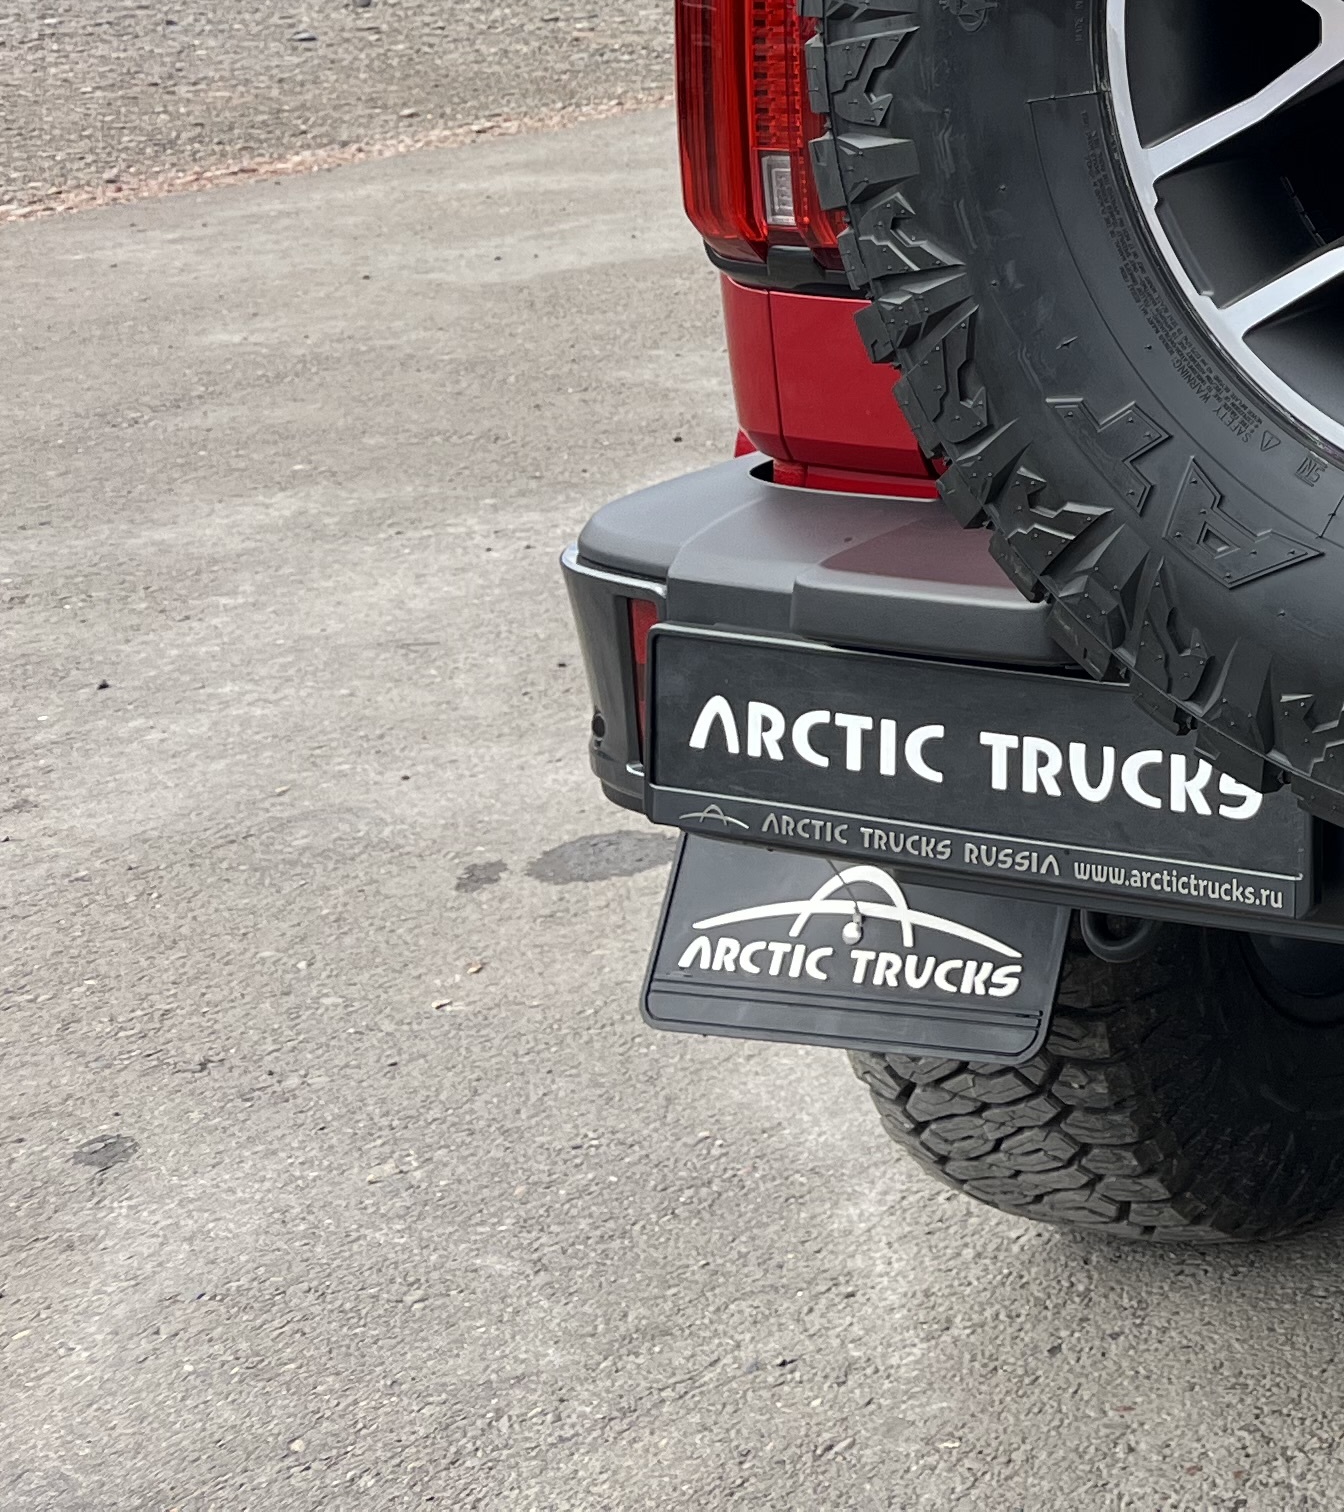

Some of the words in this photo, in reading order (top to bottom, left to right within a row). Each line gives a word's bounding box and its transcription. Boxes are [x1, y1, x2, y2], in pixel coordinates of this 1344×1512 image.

[1053, 395, 1325, 590] AT
[690, 695, 944, 783] ARCTIC
[979, 731, 1262, 822] TRUCKS
[761, 813, 848, 845] ARCTIC
[860, 827, 952, 861] TRUCKS
[964, 843, 1060, 877] RUSSIA
[1074, 861, 1284, 909] www.arctictrucks.ru
[678, 935, 833, 981] ARCTIC
[850, 950, 1022, 998] TRUCKS
